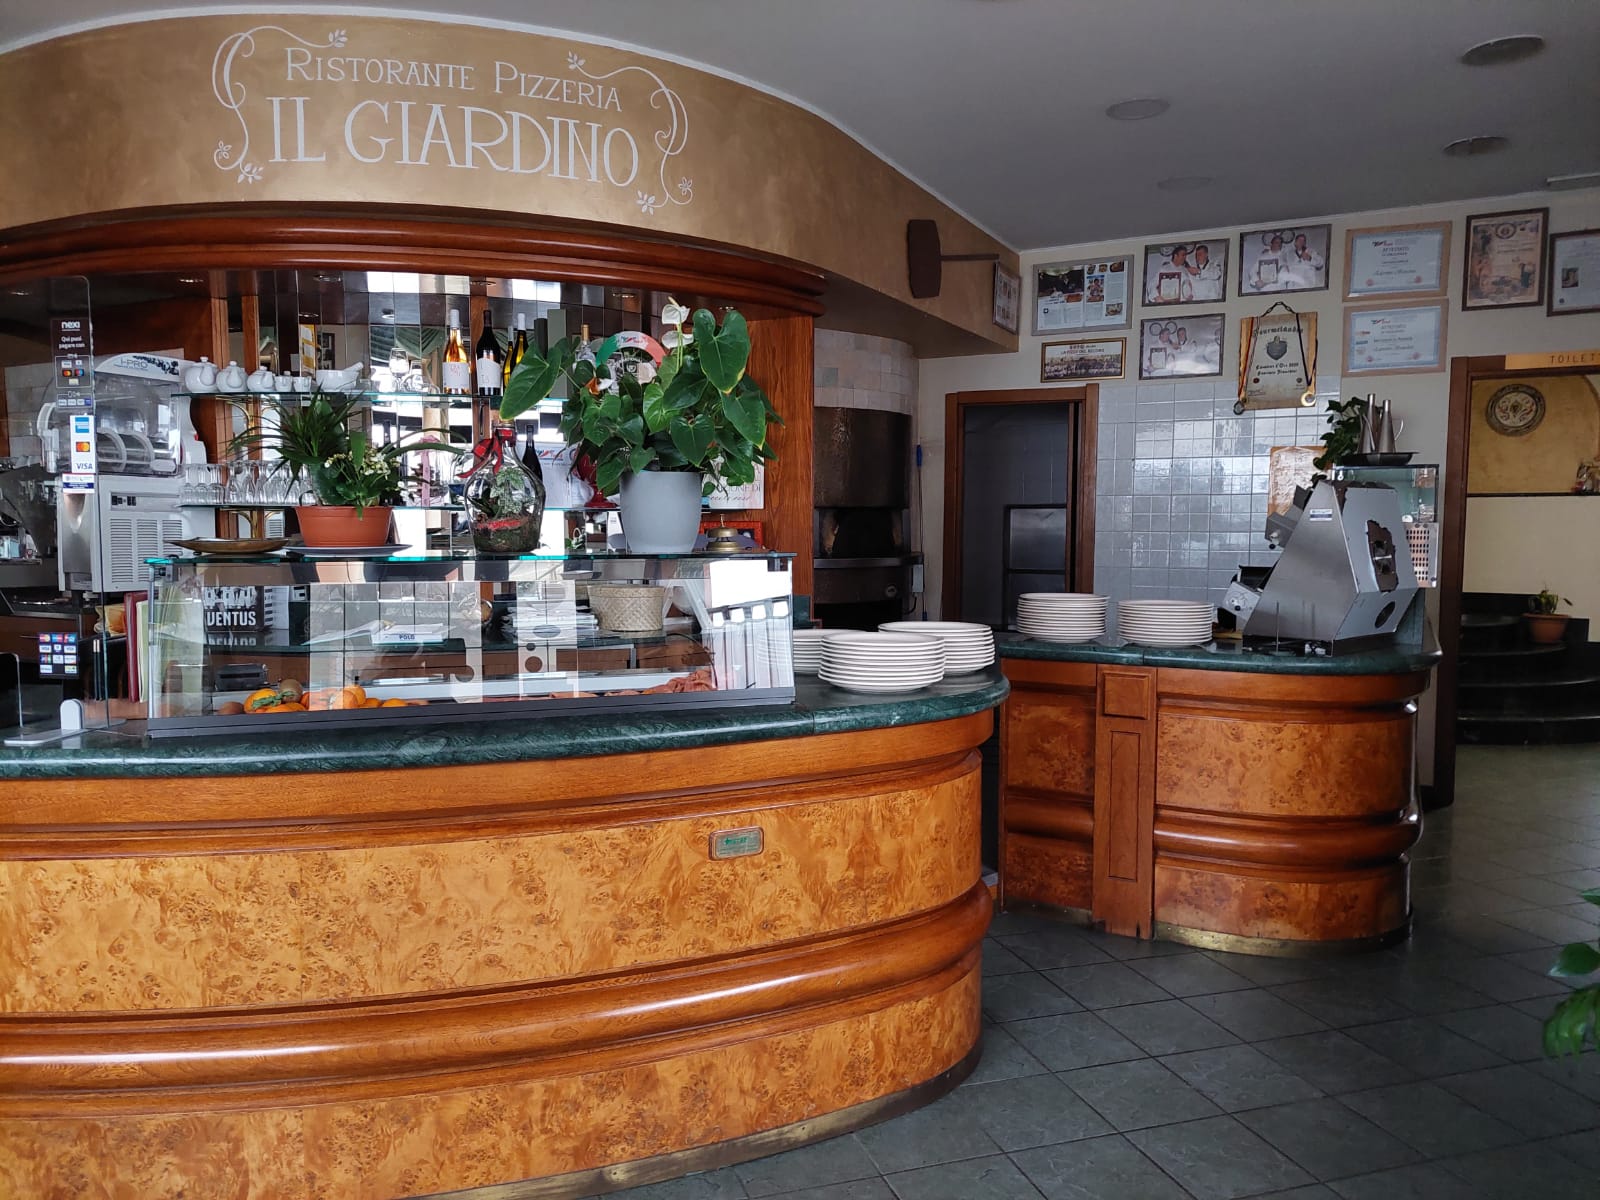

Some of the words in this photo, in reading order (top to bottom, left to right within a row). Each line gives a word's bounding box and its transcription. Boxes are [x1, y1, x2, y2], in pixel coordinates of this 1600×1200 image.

[284, 47, 475, 91] RISTORANTE
[494, 61, 623, 112] PIZZERIA
[266, 97, 326, 163] IL
[344, 100, 639, 187] GIARDINO
[1549, 352, 1600, 364] TOILET
[76, 462, 93, 470] VISA
[206, 611, 257, 626] VENTUS
